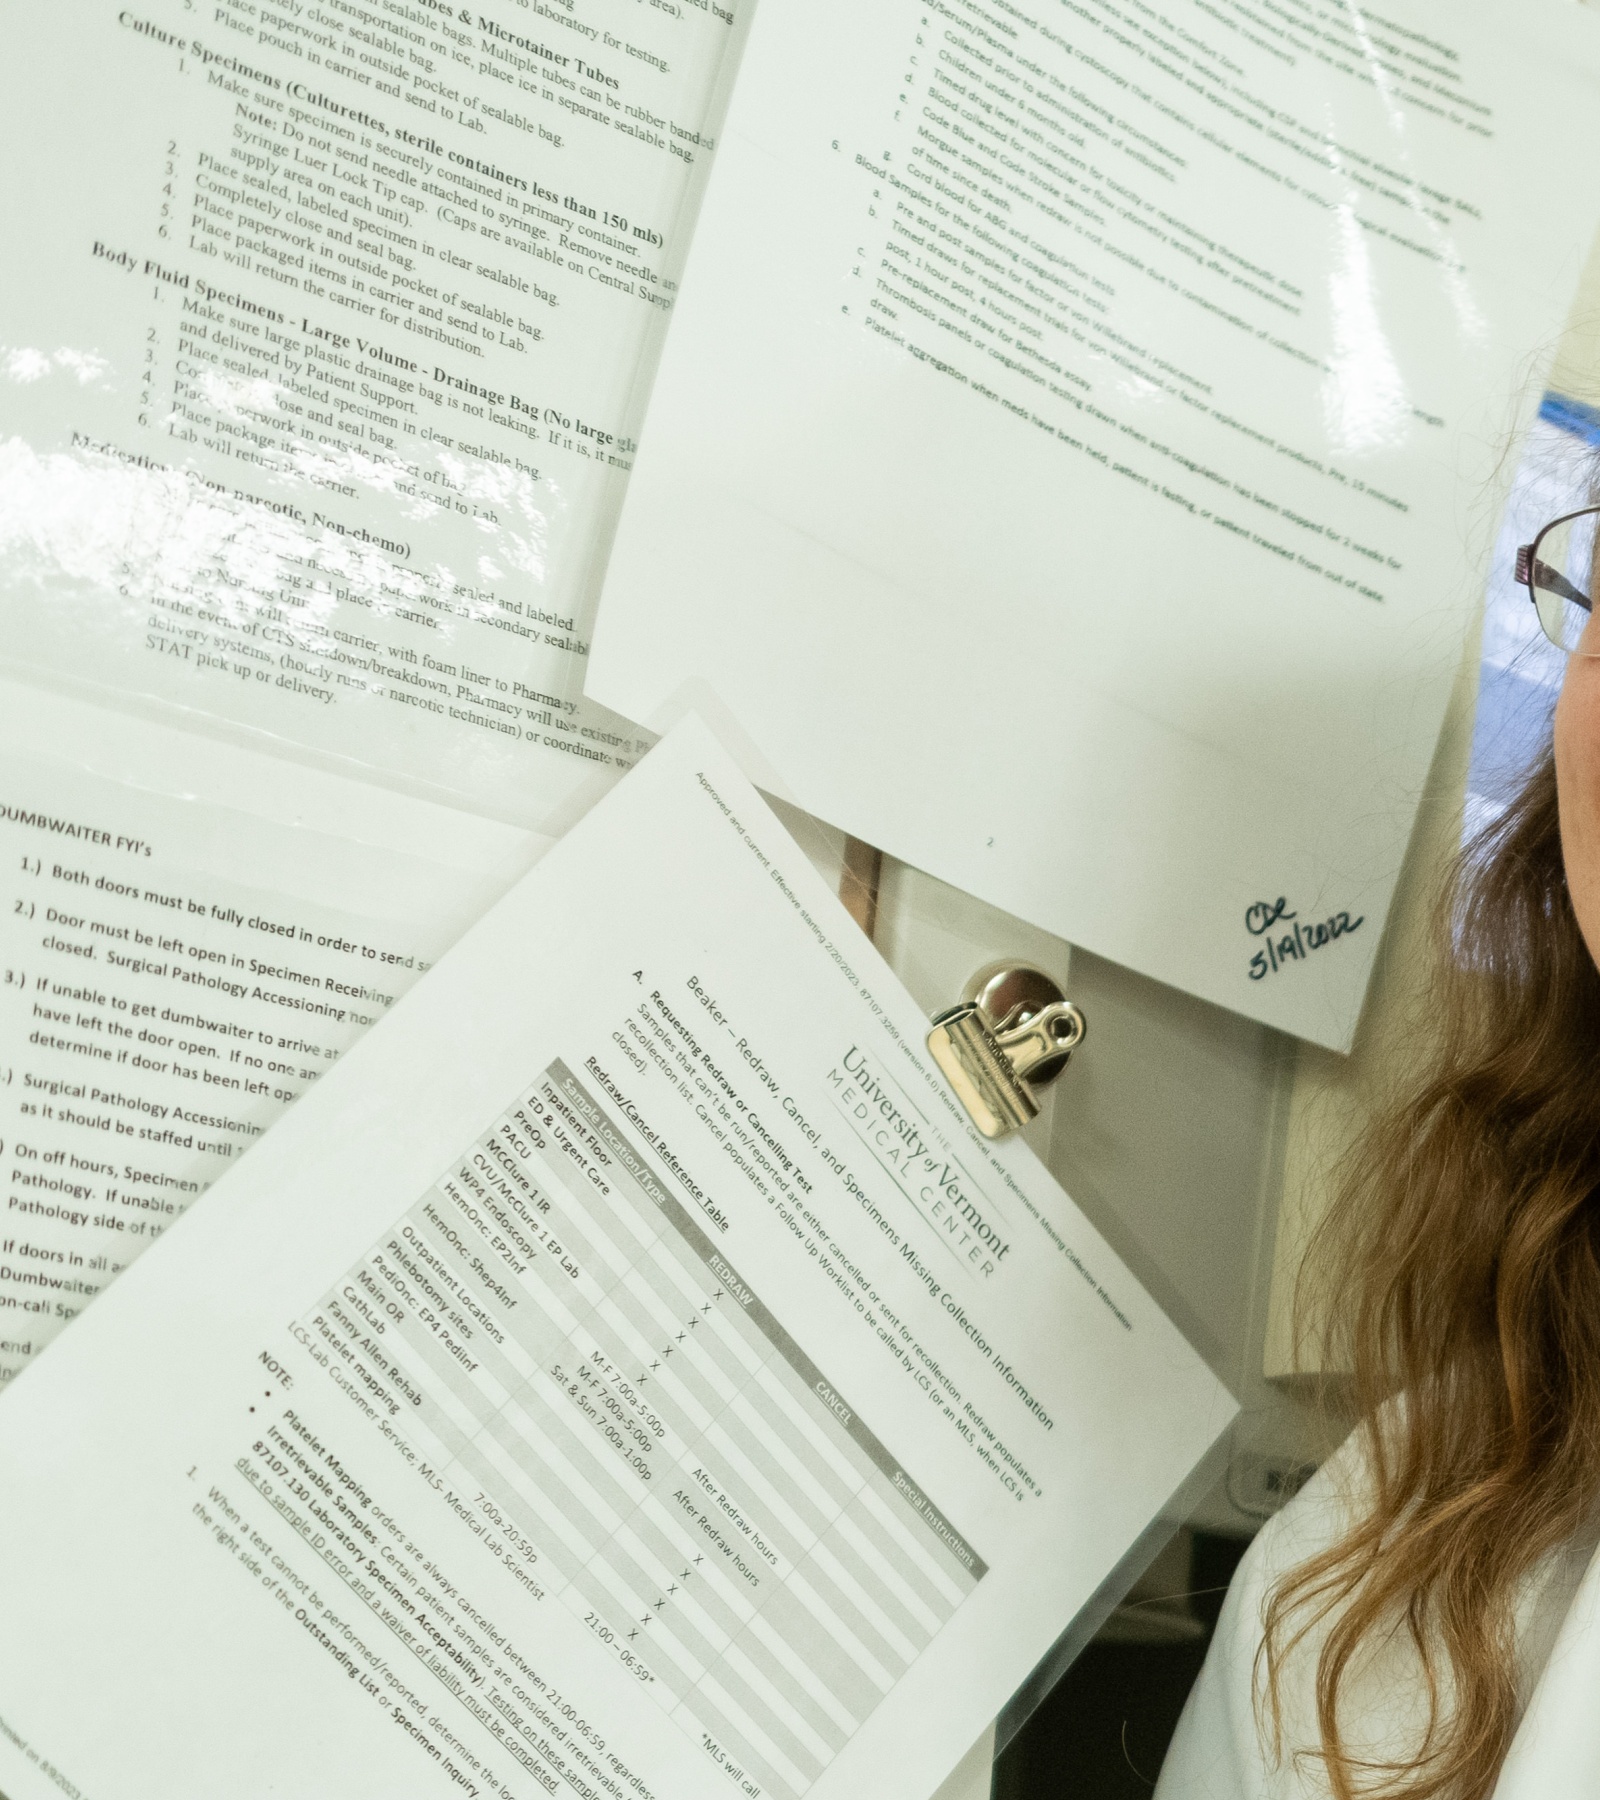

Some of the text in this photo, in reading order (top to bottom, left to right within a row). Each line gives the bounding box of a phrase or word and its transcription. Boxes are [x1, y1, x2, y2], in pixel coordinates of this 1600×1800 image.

[457, 9, 472, 26] &
[477, 15, 571, 68] Microtainer
[574, 57, 620, 91] Tubes
[117, 10, 664, 249] Culture Specimens (Culturettes, sterile containers less than 150 mls)
[91, 239, 138, 273] Body
[143, 259, 191, 290] Fluid
[194, 278, 285, 325] Specimens
[300, 317, 352, 349] Large
[355, 337, 419, 374] Volume
[432, 366, 506, 407] Drainage
[508, 394, 540, 422] Bag
[542, 408, 572, 430] (No
[574, 418, 614, 446] large
[986, 836, 995, 849] 2
[45, 907, 86, 929] Door
[89, 921, 131, 941] must
[133, 928, 154, 947] be
[157, 934, 185, 955] left
[187, 946, 227, 965] open
[230, 953, 246, 970] in
[248, 958, 321, 988] Specimen
[51, 864, 91, 886] Both
[94, 875, 140, 900] doors
[143, 890, 184, 910] must
[186, 898, 207, 917] be
[210, 904, 245, 929] fully
[247, 915, 297, 939] closed
[298, 927, 314, 944] in
[316, 935, 359, 954] order
[360, 944, 377, 960] to
[379, 951, 415, 969] send
[769, 868, 802, 910] Effective
[799, 908, 827, 945] starting
[1248, 911, 1364, 980] 5/19/2022
[513, 1109, 547, 1150] PreOp
[540, 1081, 613, 1167] Inpatient Floor
[649, 989, 703, 1058] Requesting
[700, 1053, 738, 1100] Redraw
[735, 1099, 749, 1113] or
[747, 1112, 794, 1172] Cancelling
[792, 1166, 813, 1195] Test
[499, 1124, 532, 1160] PACU
[527, 1095, 610, 1196] ED & Urgent Care
[562, 1077, 666, 1204] Sample Location/Type
[583, 1055, 730, 1232] Redraw/Cancel Reference Table
[825, 1067, 995, 1279] MEDICAL CENTER
[842, 1044, 1010, 1262] University of Vermont
[422, 1202, 472, 1260] HemOnc:
[443, 1181, 492, 1235] HemOnc:
[458, 1165, 538, 1260] WP4 Endoscopy
[535, 1197, 552, 1215] IR
[685, 974, 729, 1027] Beaker
[734, 1037, 781, 1100] Redraw,
[781, 1096, 822, 1150] Cancel,
[820, 1147, 848, 1176] and
[841, 1172, 901, 1246] Specimens
[898, 1242, 942, 1298] Missing
[940, 1292, 993, 1359] Collection
[991, 1354, 1054, 1432] Information
[371, 1254, 420, 1310] PediOnc:
[417, 1306, 442, 1333] EP4
[386, 1239, 474, 1340] Phlebotomy sites
[401, 1225, 505, 1345] Outpatient Locations
[546, 1239, 563, 1256] EP
[559, 1255, 580, 1280] Lab
[709, 1254, 754, 1305] REDRAW
[327, 1299, 423, 1407] Fanny Allen Rehab
[342, 1285, 386, 1335] CathLab
[257, 1349, 295, 1392] NOTE:
[590, 1350, 666, 1438] M-F 7:00a-5:00p
[816, 1381, 852, 1425] CANCEL
[549, 1364, 653, 1481] Sat & Sun 7:00a-1:00p
[266, 1424, 381, 1549] Irretrievable Samples:
[691, 1468, 778, 1566] After Redraw hours
[892, 1471, 974, 1567] Special Instructions
